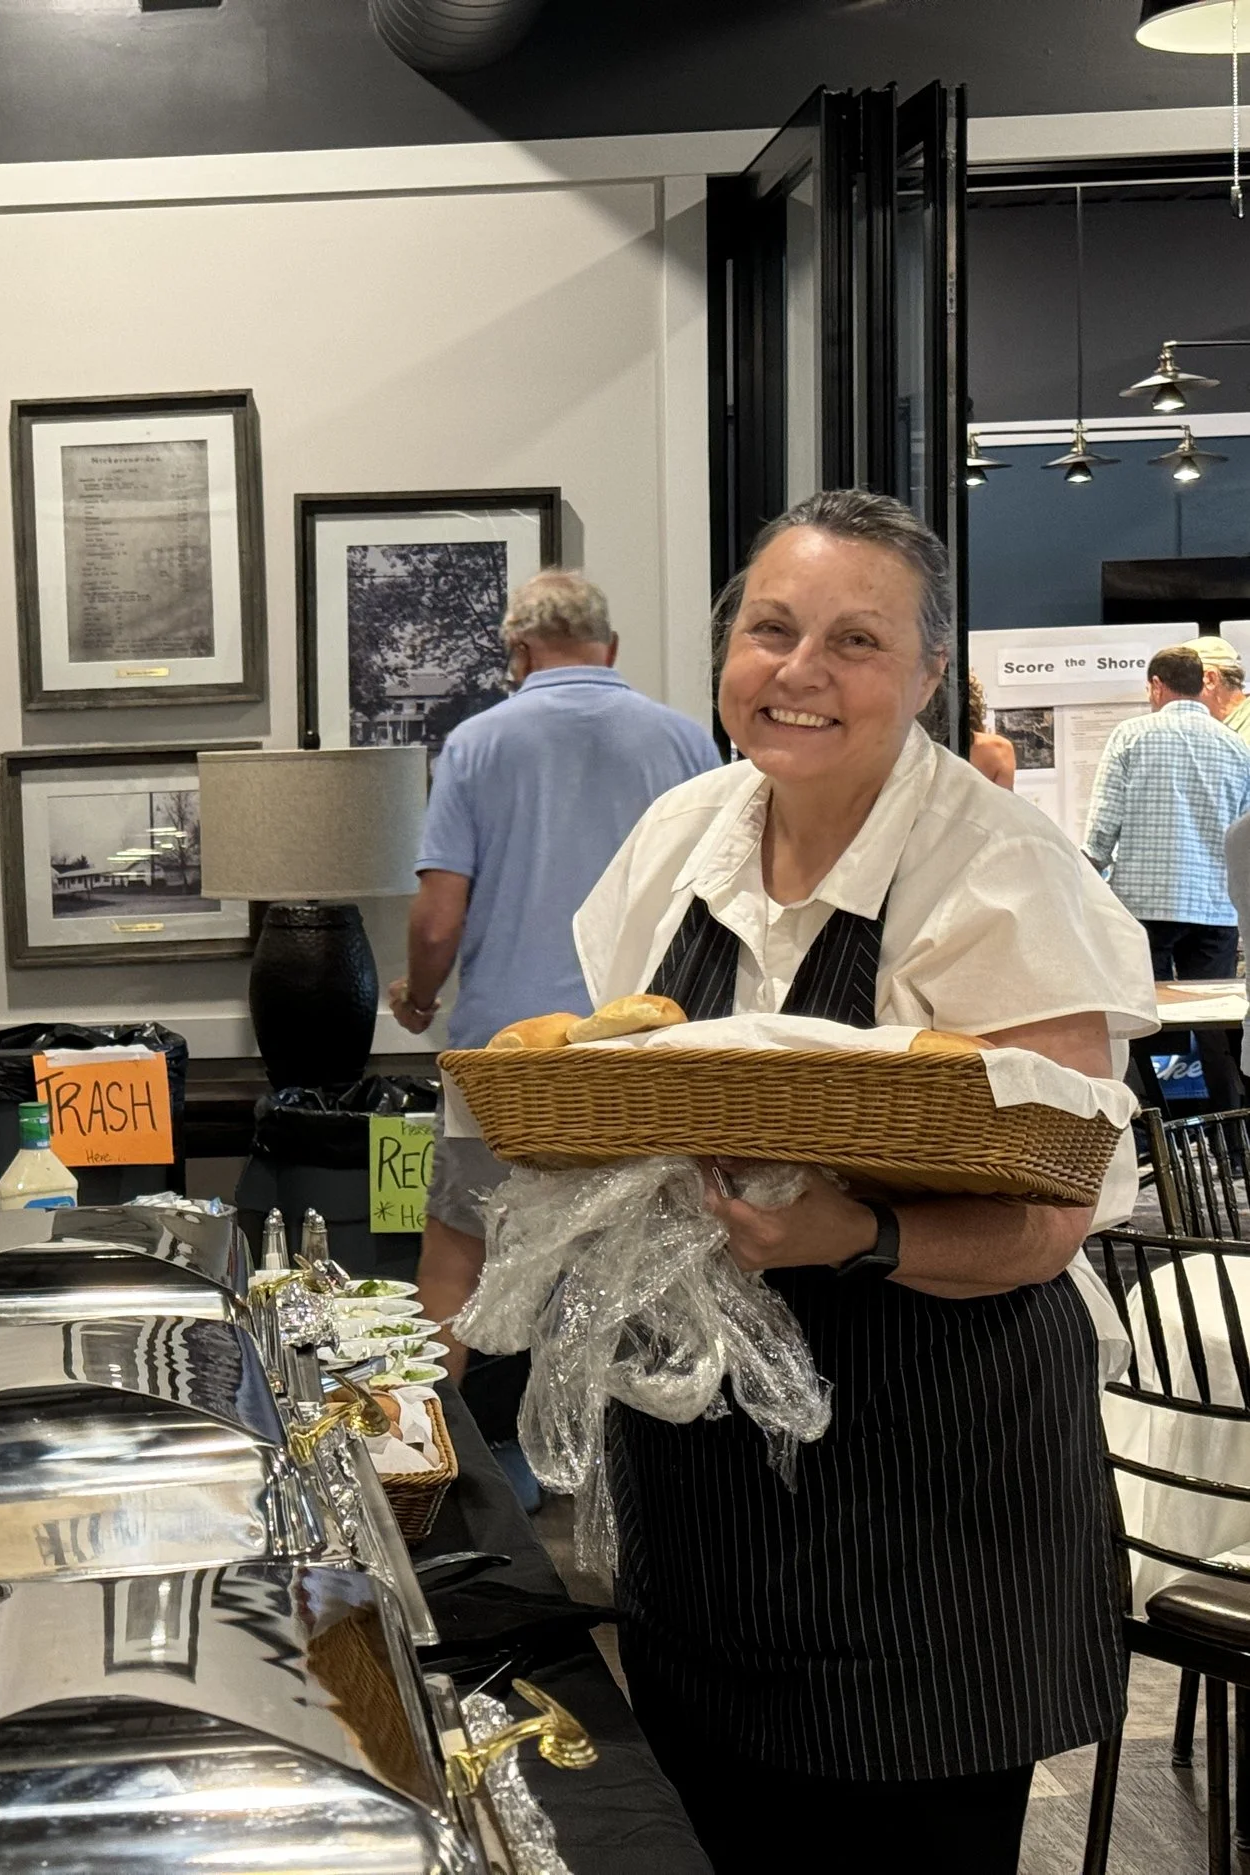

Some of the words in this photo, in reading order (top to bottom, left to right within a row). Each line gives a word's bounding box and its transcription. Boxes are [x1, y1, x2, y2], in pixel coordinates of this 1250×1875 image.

[1004, 662, 1054, 674] Score
[1065, 658, 1086, 667] the
[1097, 657, 1146, 669] Shore
[36, 1071, 157, 1137] TRASH
